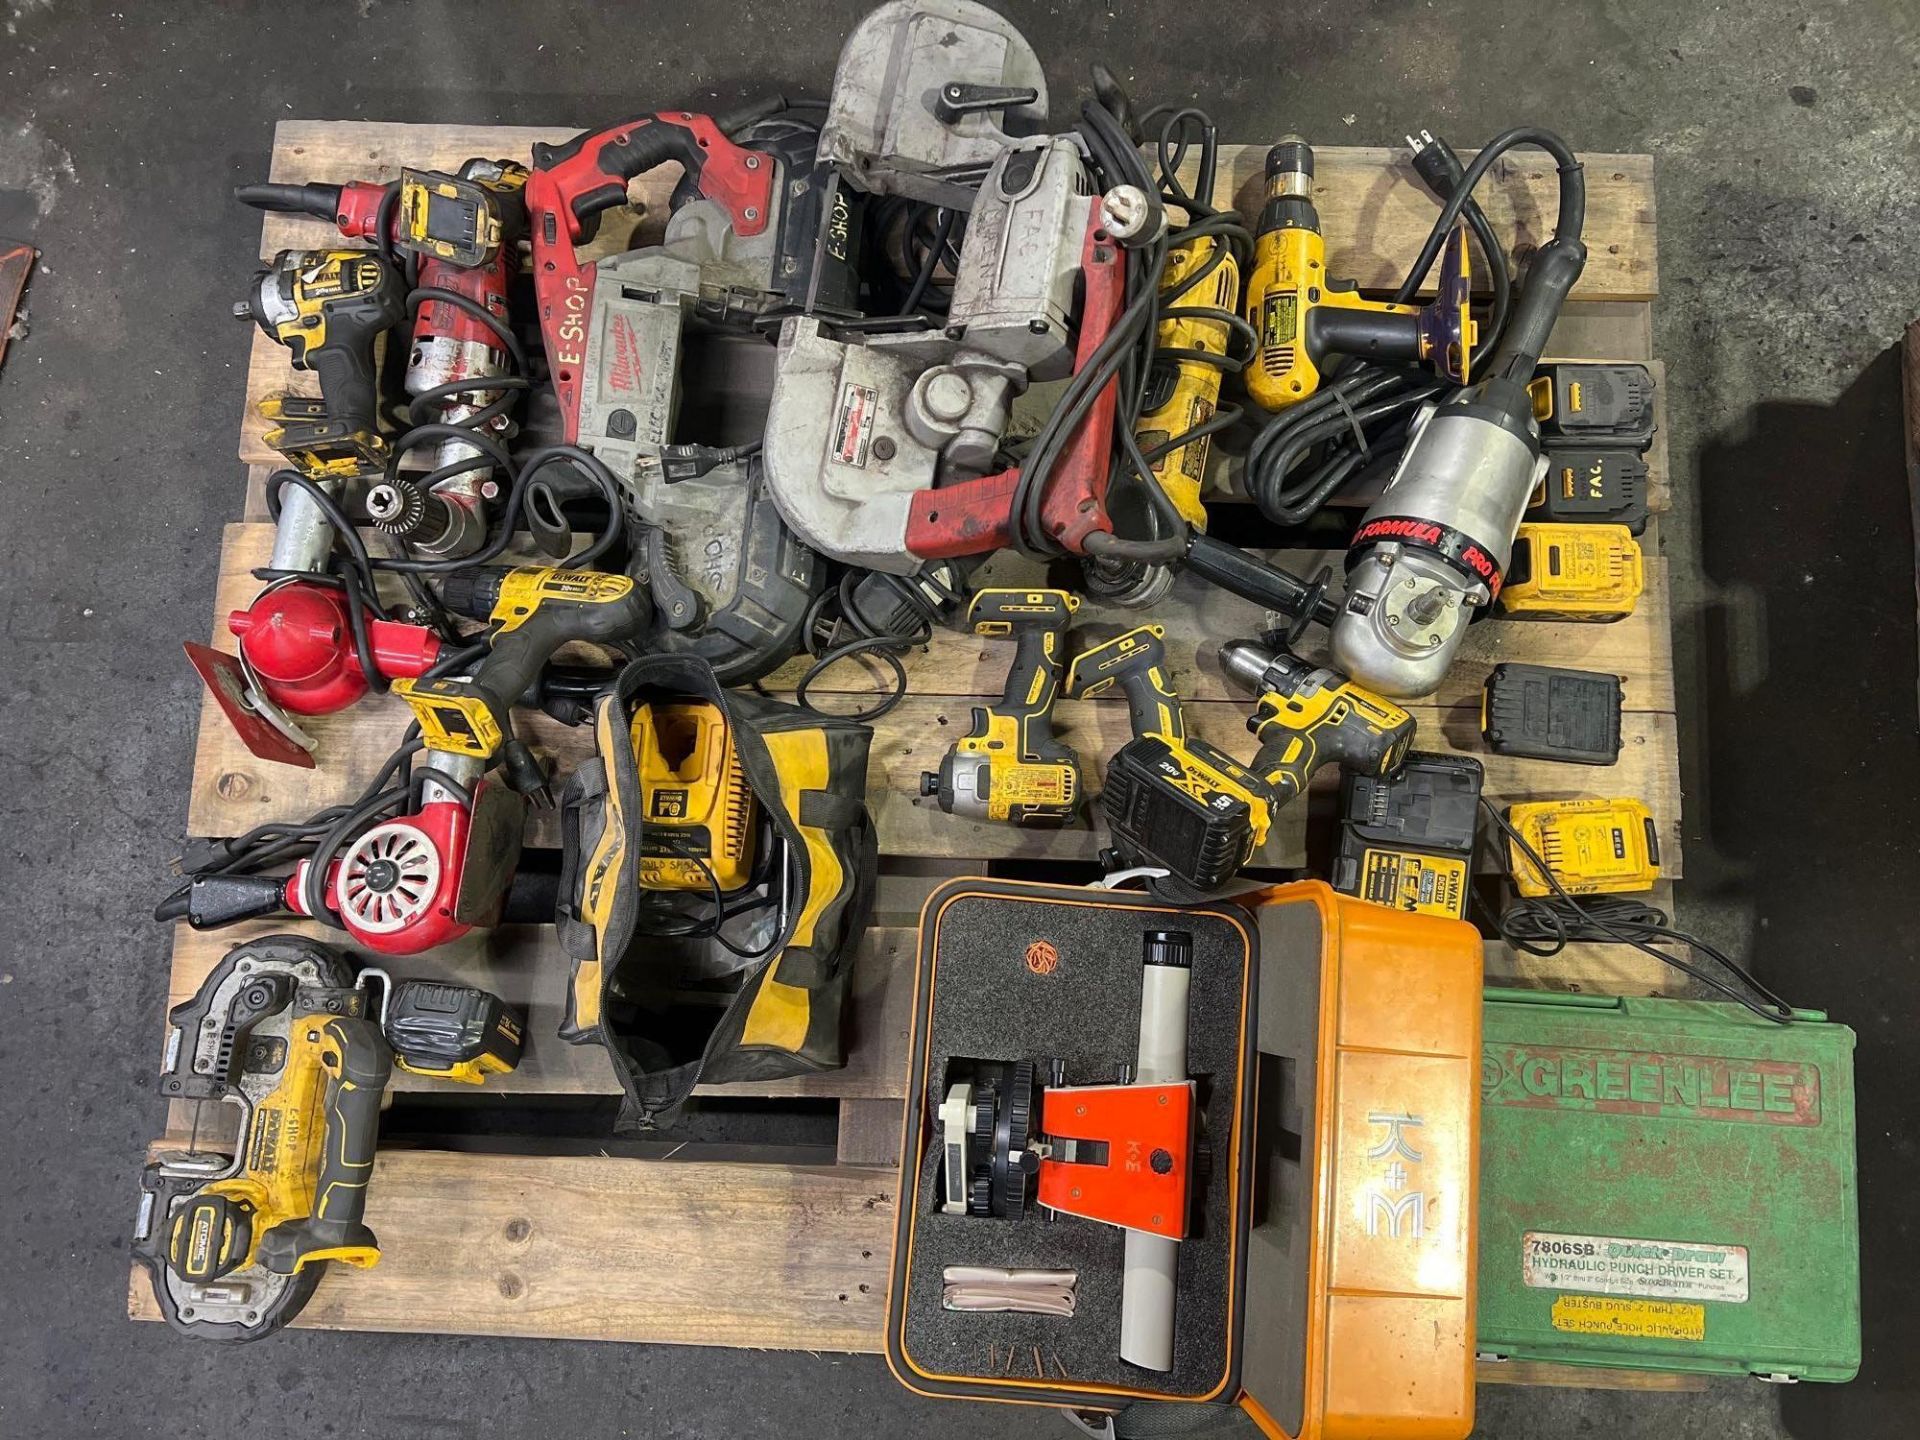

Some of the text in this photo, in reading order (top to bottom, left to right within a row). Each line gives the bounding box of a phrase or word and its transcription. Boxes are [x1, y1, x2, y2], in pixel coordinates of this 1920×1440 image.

[558, 277, 589, 365] E-SHOP
[608, 313, 635, 392] Milwaukee
[1361, 520, 1442, 545] FORMULA
[1461, 545, 1493, 577] PRO
[1214, 794, 1234, 808] 5
[1521, 1056, 1796, 1113] GREENLEE
[198, 1220, 209, 1262] ATOMIC
[1531, 1240, 1595, 1256] 7806SB
[1532, 1258, 1734, 1281] HYDRAULIC PUNCH DRIVER SET
[1563, 1298, 1602, 1310] BUSTER
[1605, 1301, 1632, 1312] SLUG
[1647, 1304, 1674, 1315] THRU
[1556, 1318, 1703, 1337] HYDRAULIC HOLE PUNCH SET
